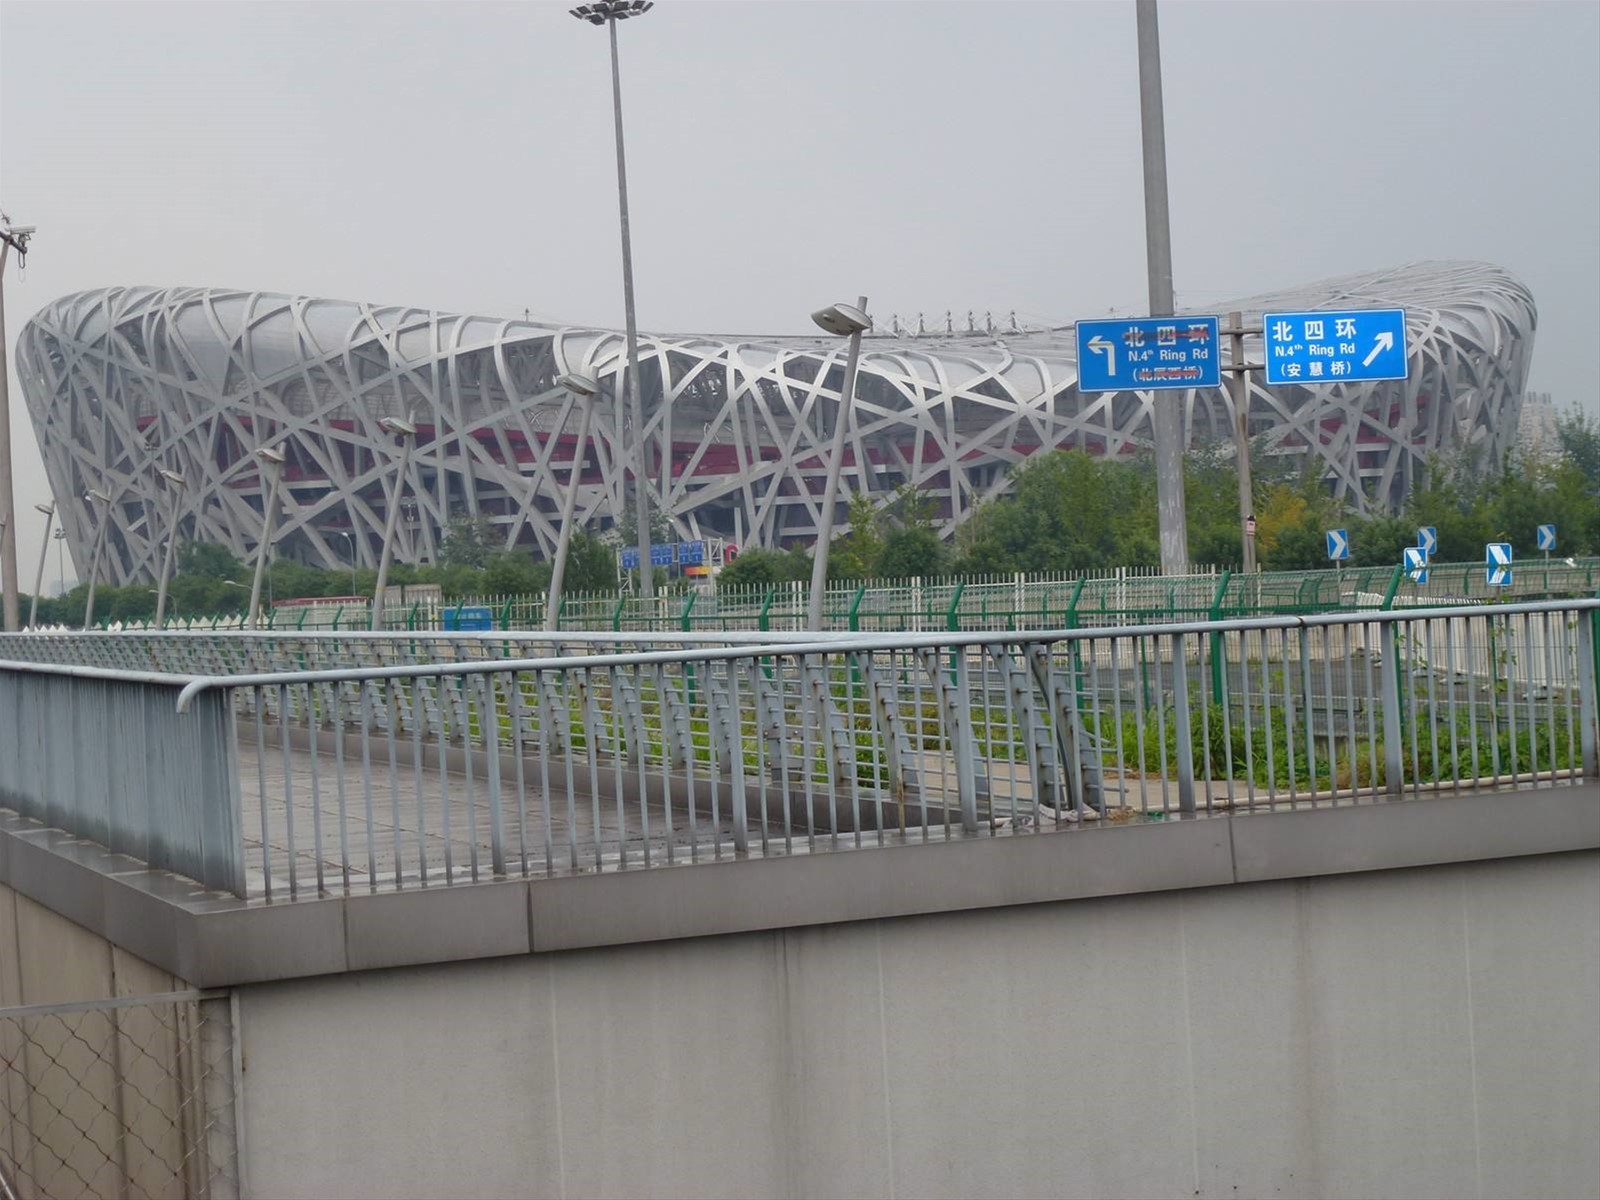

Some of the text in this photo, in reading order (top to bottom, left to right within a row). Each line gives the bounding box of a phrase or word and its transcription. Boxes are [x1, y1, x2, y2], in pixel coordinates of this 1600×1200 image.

[1123, 324, 1210, 348] 北四环
[1272, 318, 1357, 342] 北四环
[1128, 348, 1208, 362] N.4th Ring Rd
[1275, 343, 1355, 357] N.4th Ring Rd
